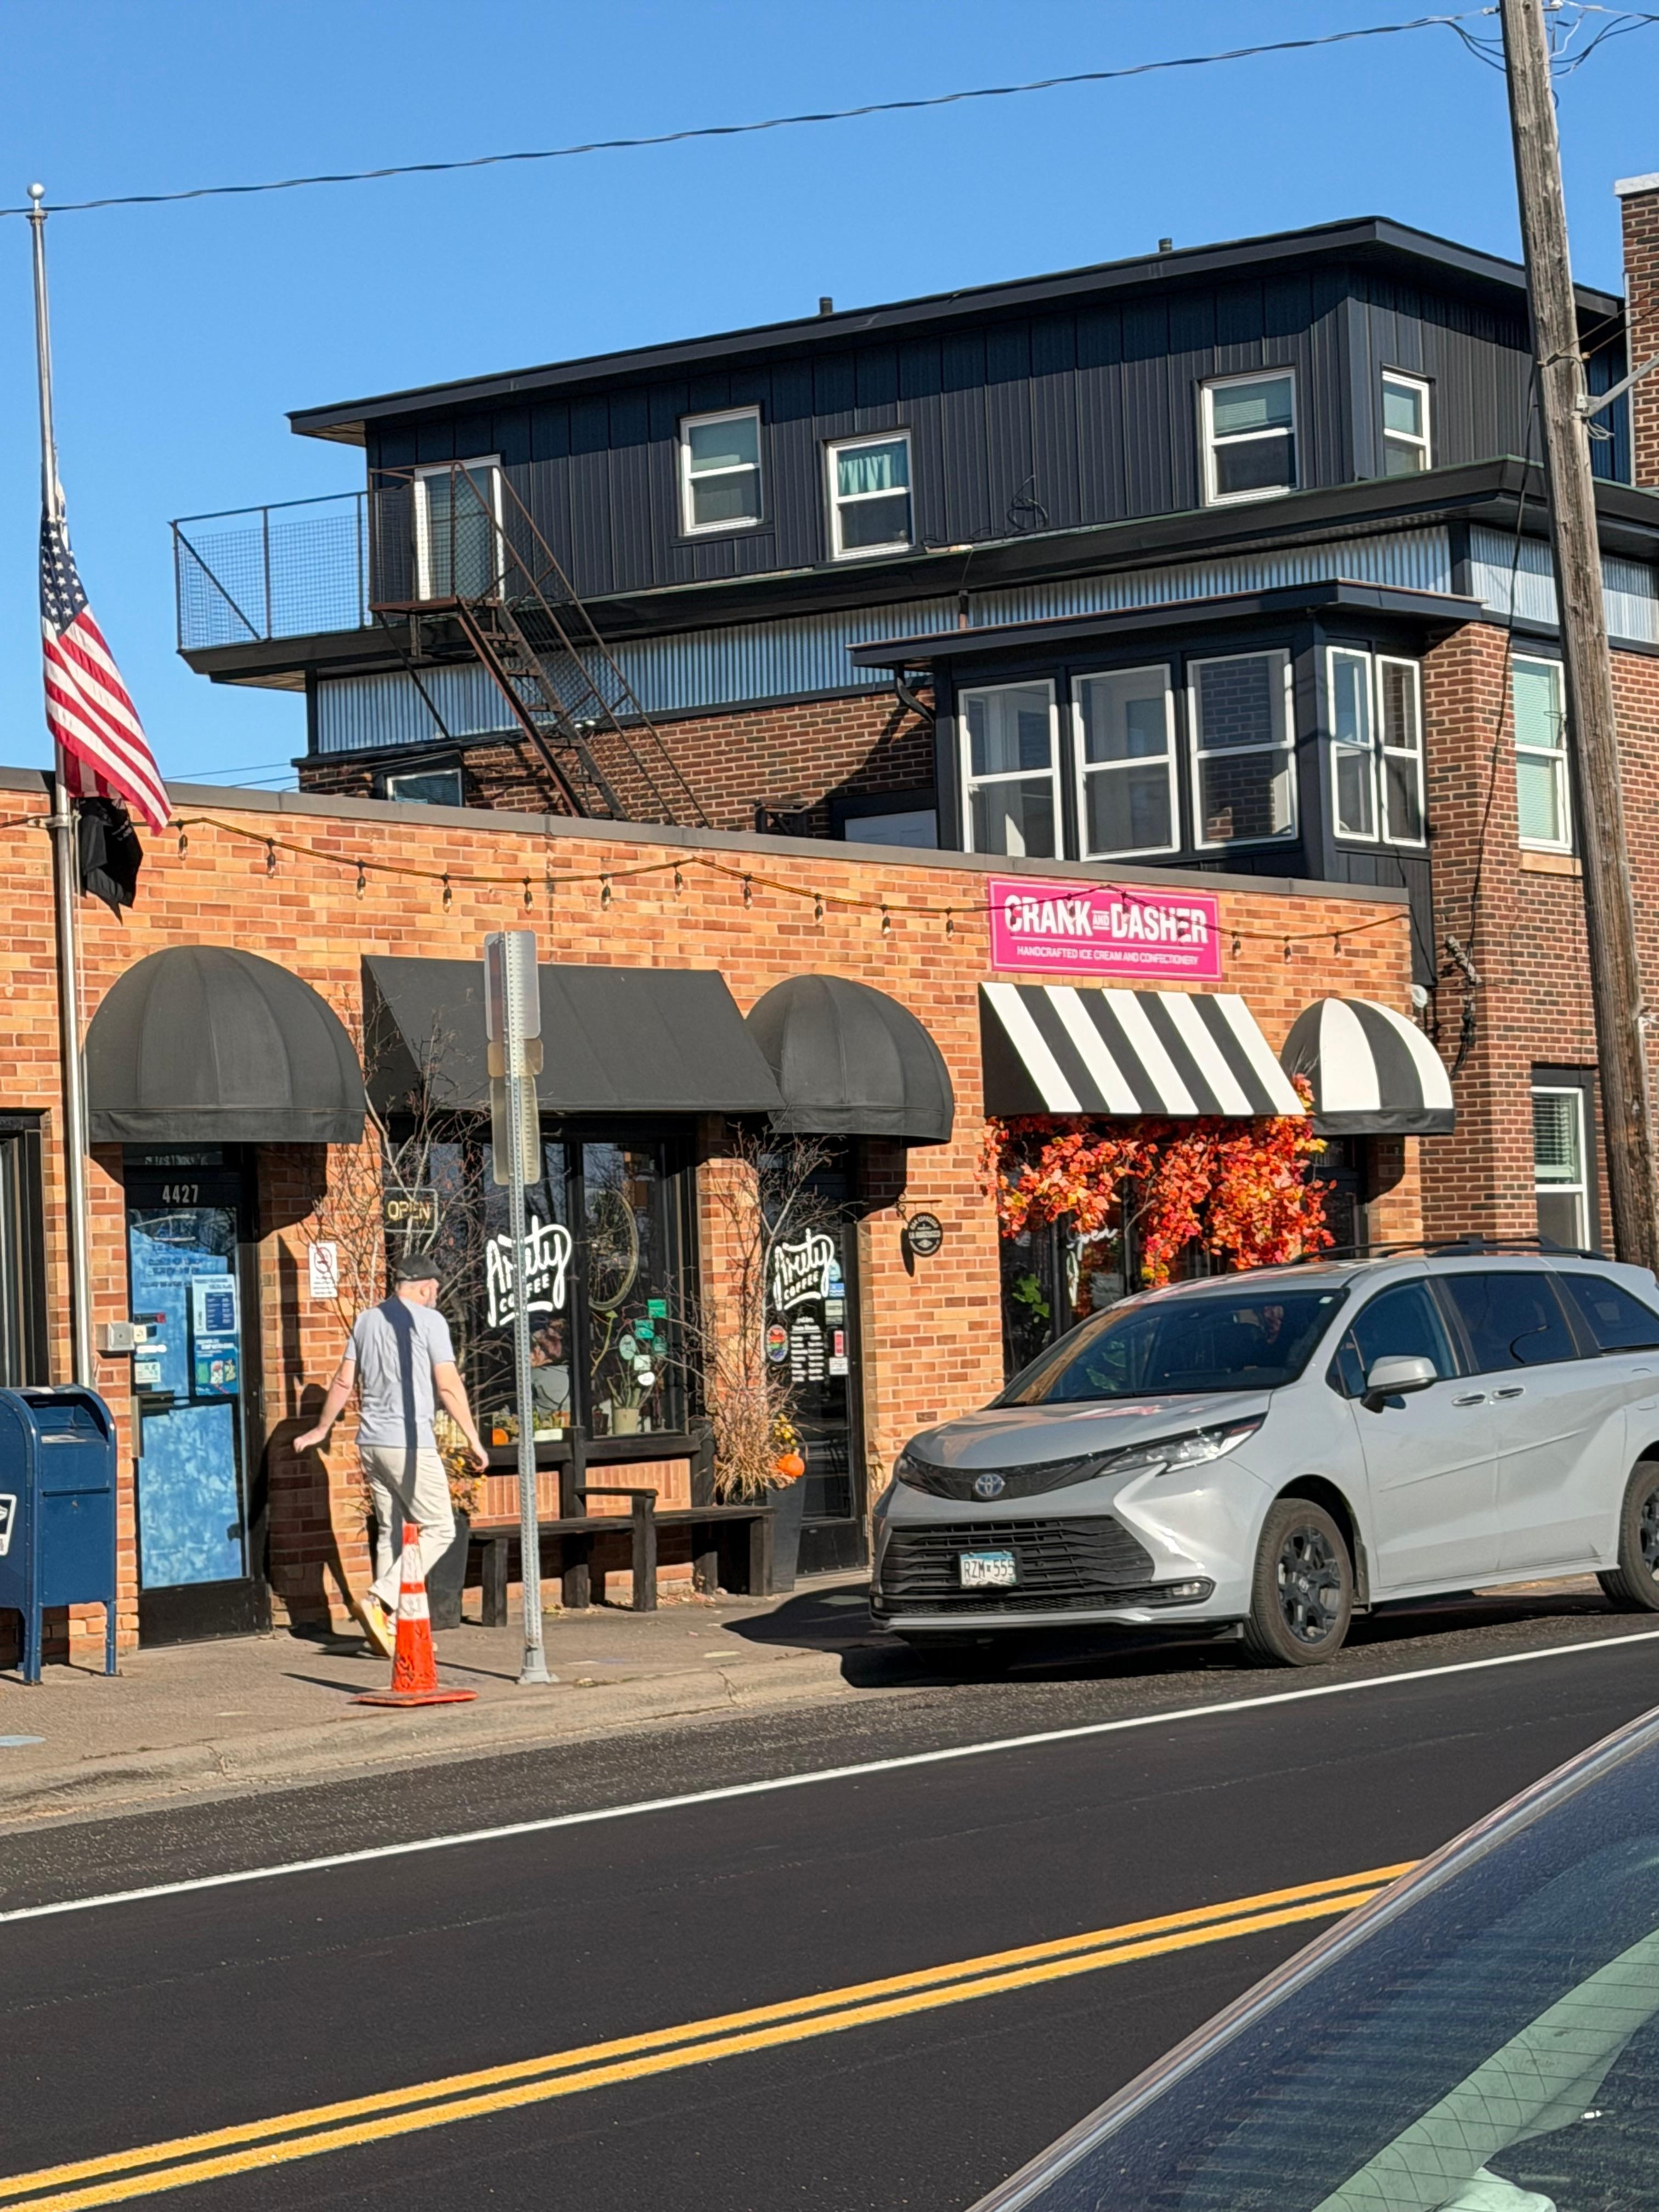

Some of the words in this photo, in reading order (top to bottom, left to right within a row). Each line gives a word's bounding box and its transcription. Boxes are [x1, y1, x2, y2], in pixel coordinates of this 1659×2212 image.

[1005, 895, 1093, 936] CRANK
[1093, 914, 1109, 926] AND
[1110, 902, 1209, 944] DASHER
[1017, 946, 1079, 959] HANDCRAFTED
[1079, 949, 1093, 960] ICE
[1093, 950, 1122, 961] CREAM
[1123, 951, 1139, 963] AND
[1139, 952, 1199, 966] CONFECTIONERY
[162, 1184, 199, 1204] 4427
[387, 1200, 431, 1221] OPEN
[499, 1273, 550, 1312] COFEE
[783, 1271, 819, 1301] COFFEE
